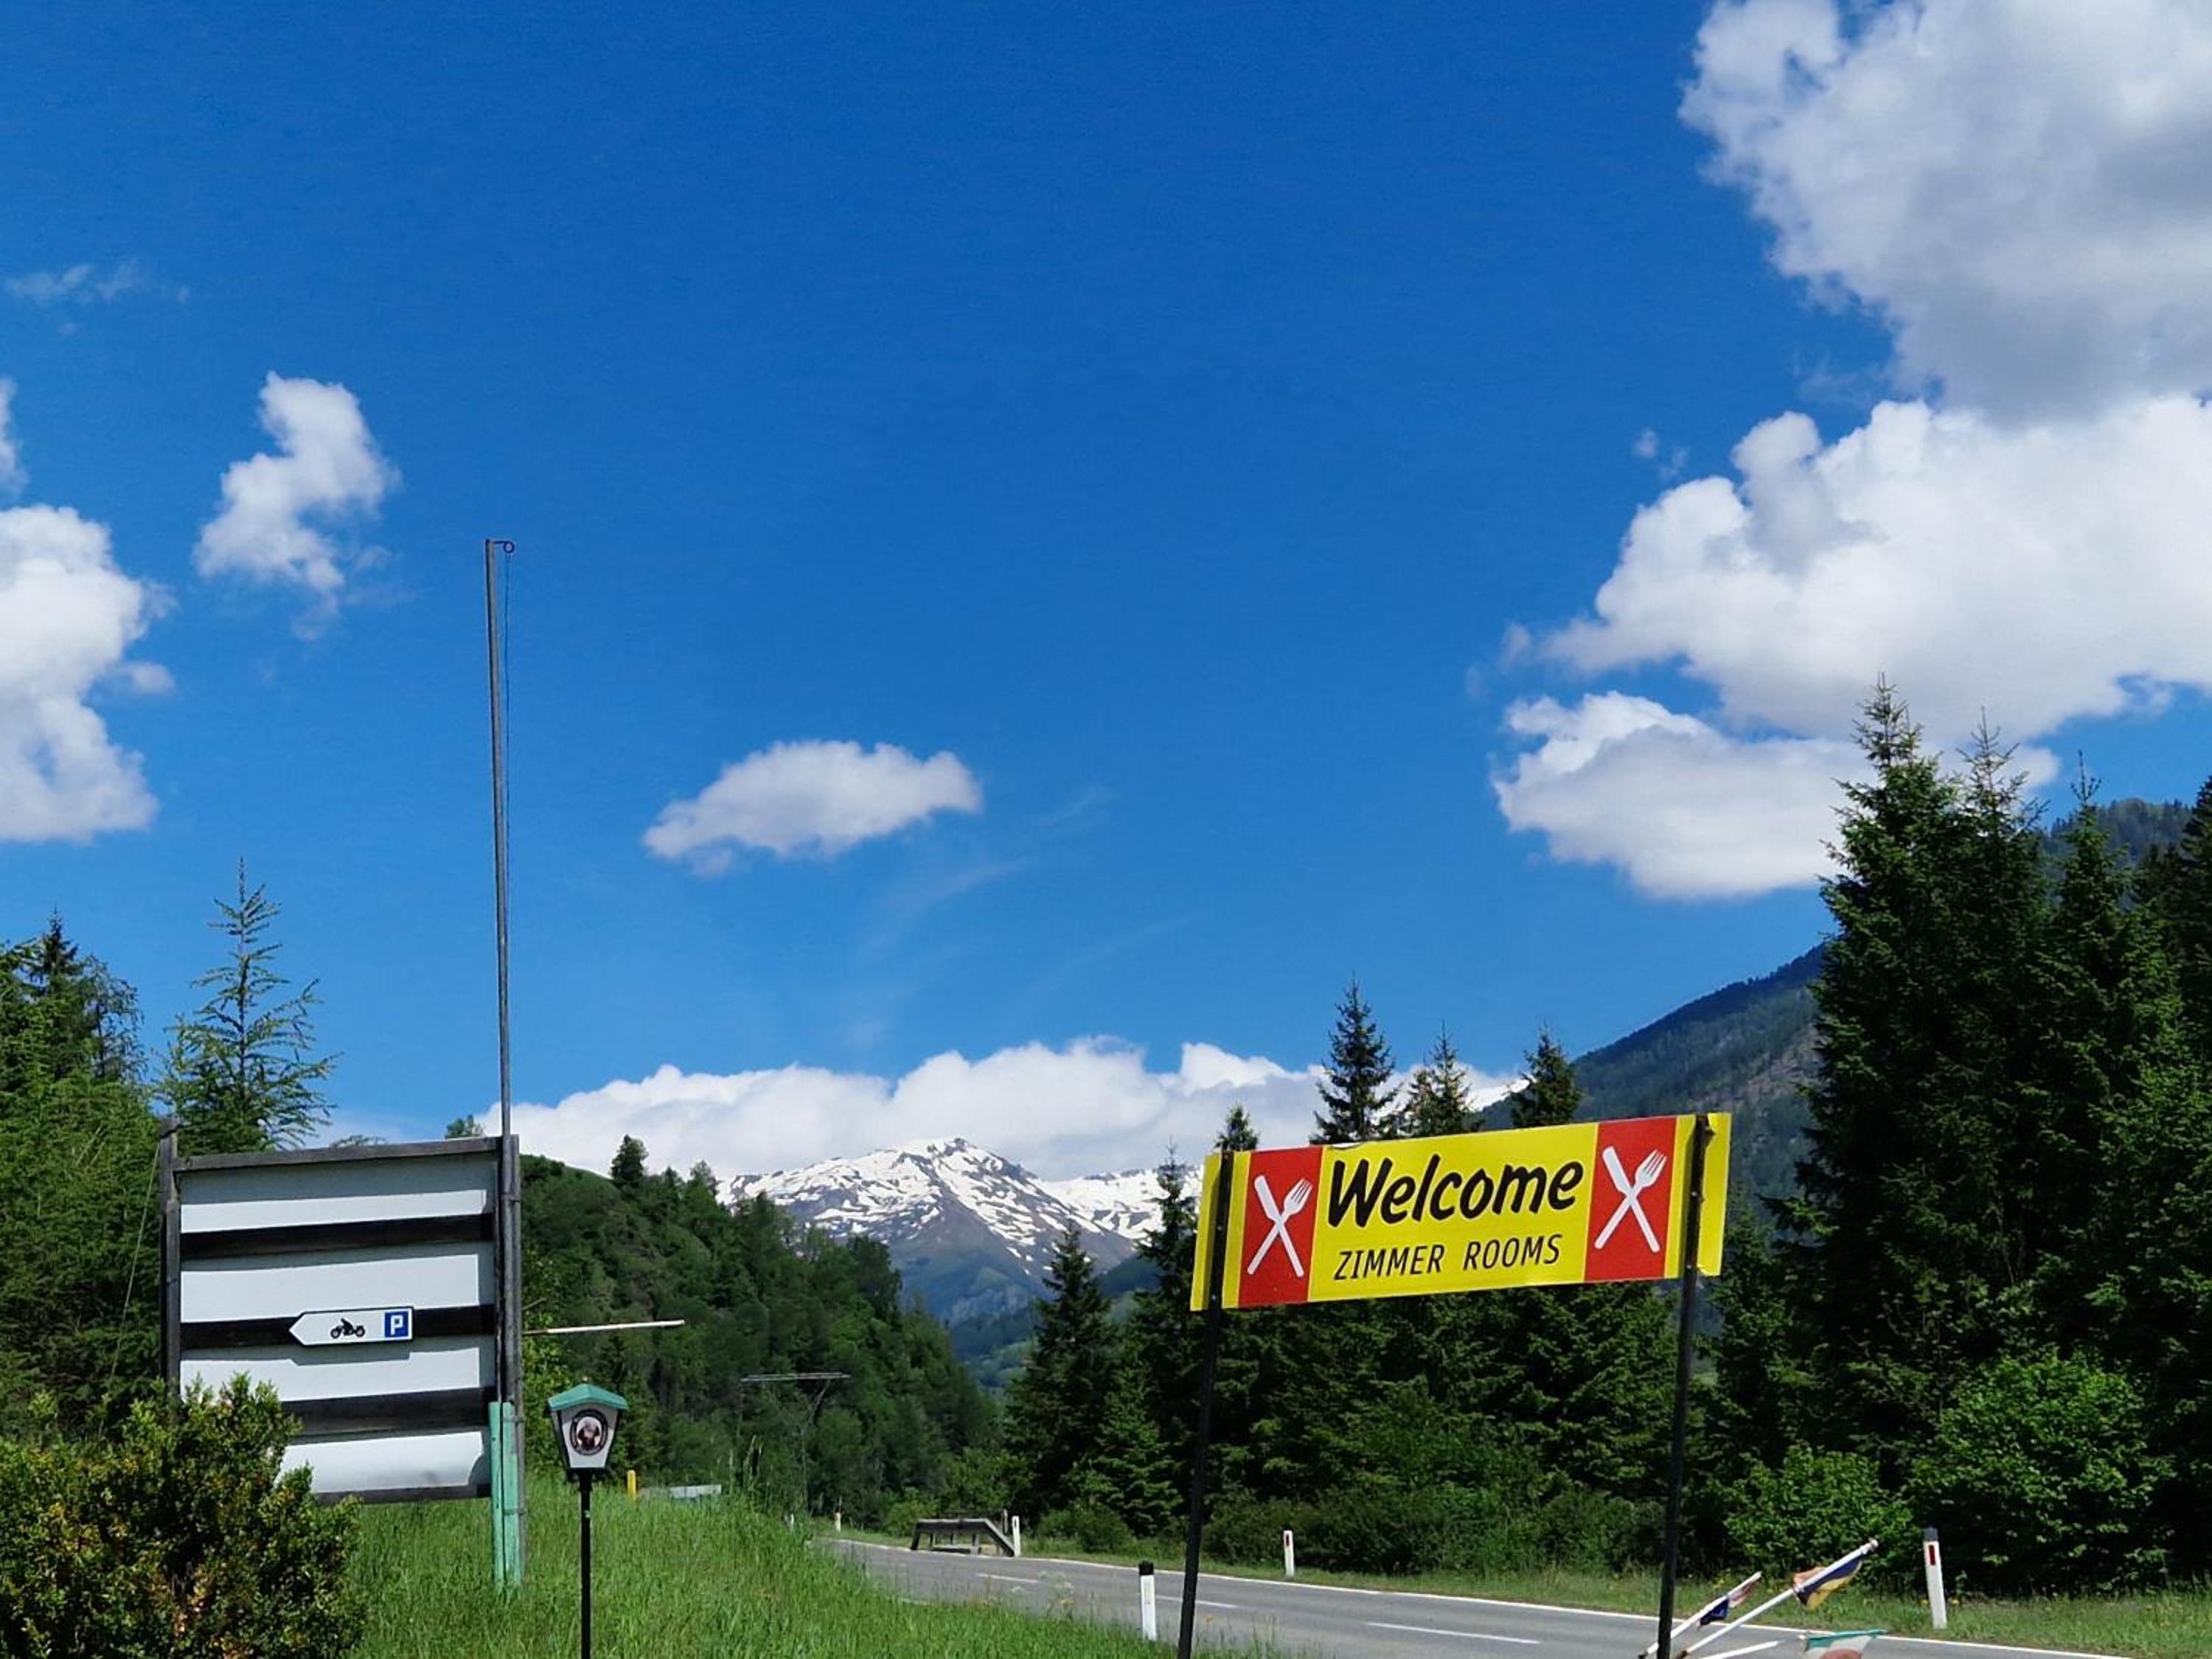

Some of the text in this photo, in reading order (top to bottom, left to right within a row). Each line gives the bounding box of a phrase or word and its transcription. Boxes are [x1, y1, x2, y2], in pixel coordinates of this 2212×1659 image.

[1328, 1154, 1584, 1228] Welcome
[1334, 1234, 1562, 1281] ZIMMER ROOMS
[390, 1315, 403, 1335] P
